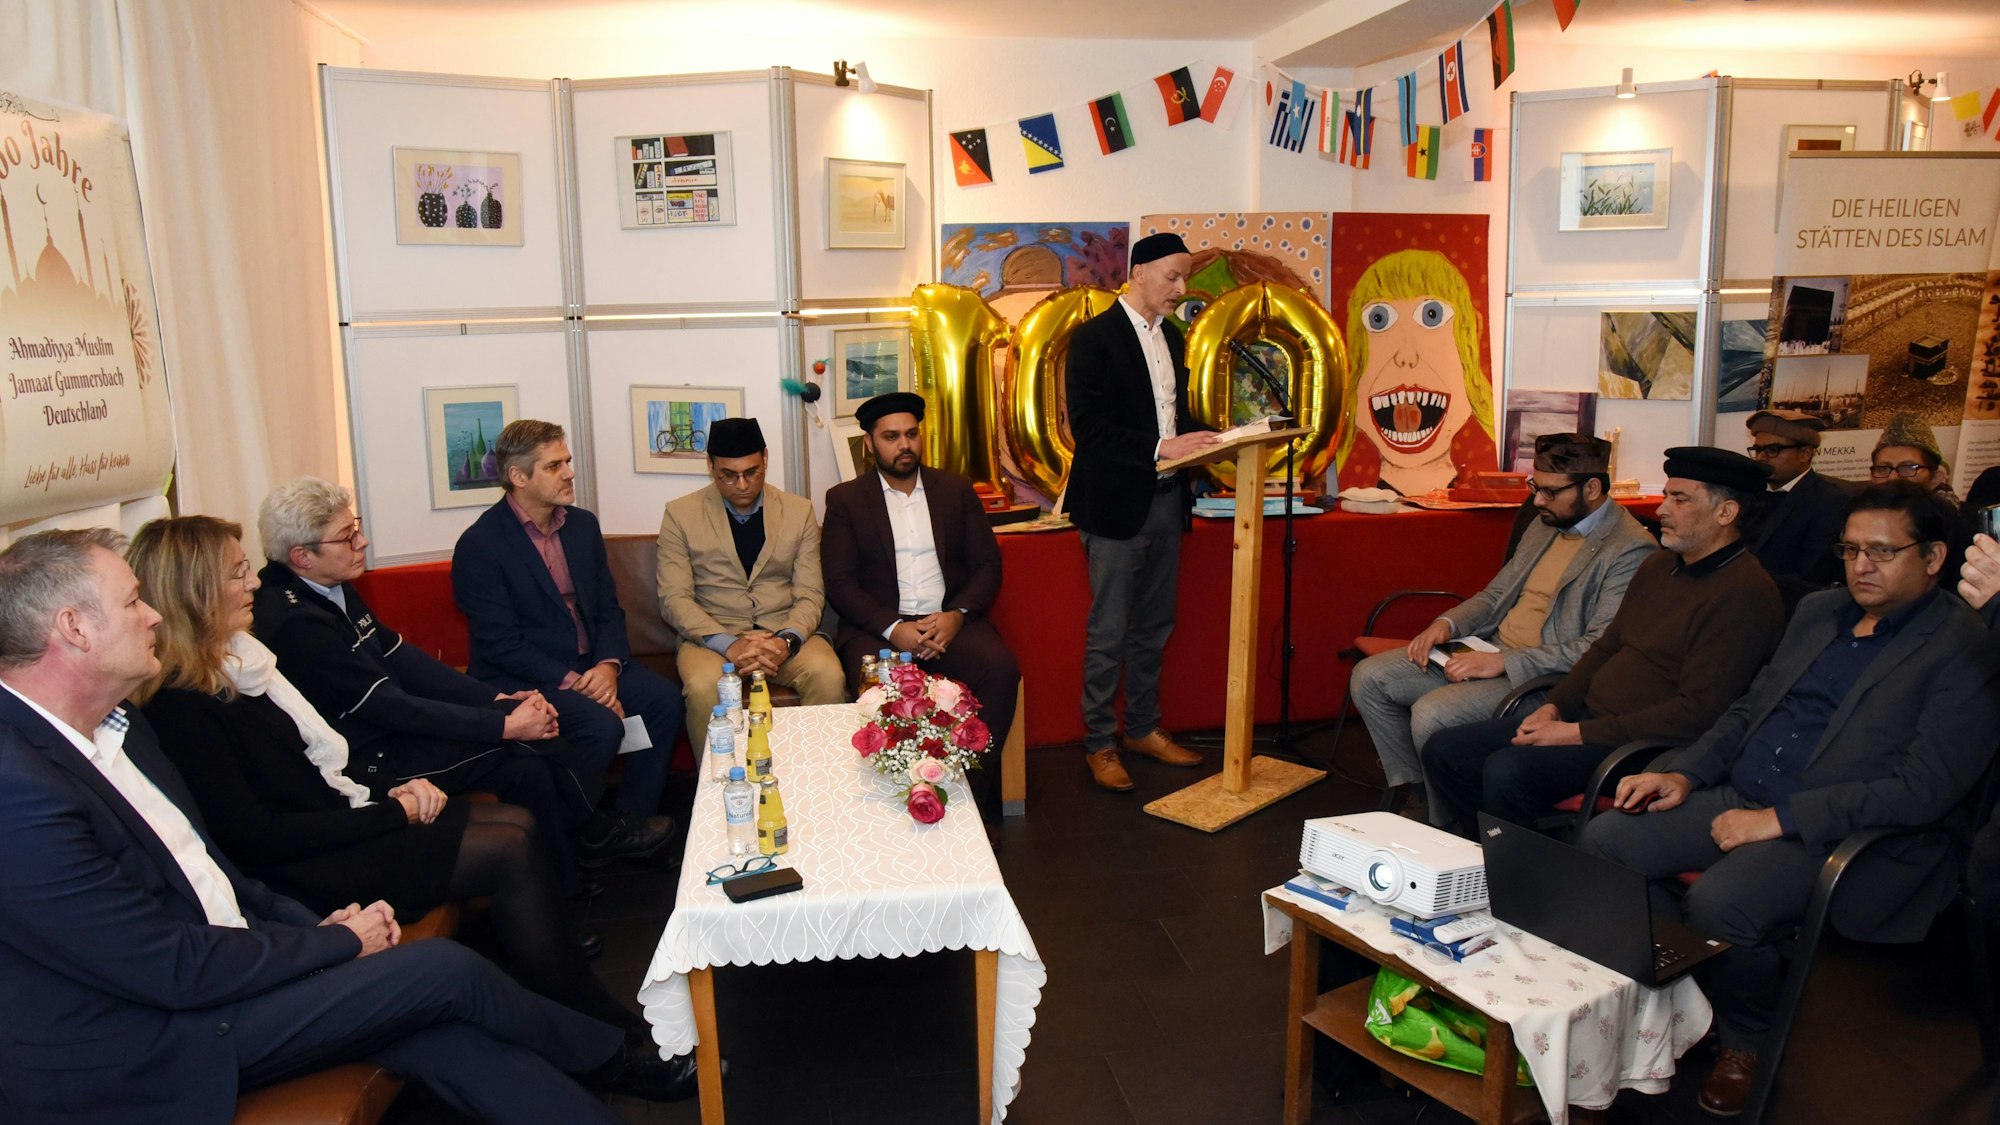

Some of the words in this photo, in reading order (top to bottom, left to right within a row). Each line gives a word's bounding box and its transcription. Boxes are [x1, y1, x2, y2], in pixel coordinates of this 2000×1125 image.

[21, 119, 93, 203] Jahre
[1832, 198, 1865, 218] DIE
[1868, 198, 1961, 218] HEILIGEN
[1796, 225, 1882, 249] STÄTTEN
[1886, 228, 1924, 248] DES
[1927, 227, 1987, 247] ISLAM
[9, 336, 75, 364] Ahmadiyya
[75, 332, 115, 357] Muslim
[9, 372, 54, 400] Jamaat
[55, 366, 124, 398] Gummersbach
[43, 398, 107, 427] Deutschland
[1823, 446, 1856, 456] MEKKA
